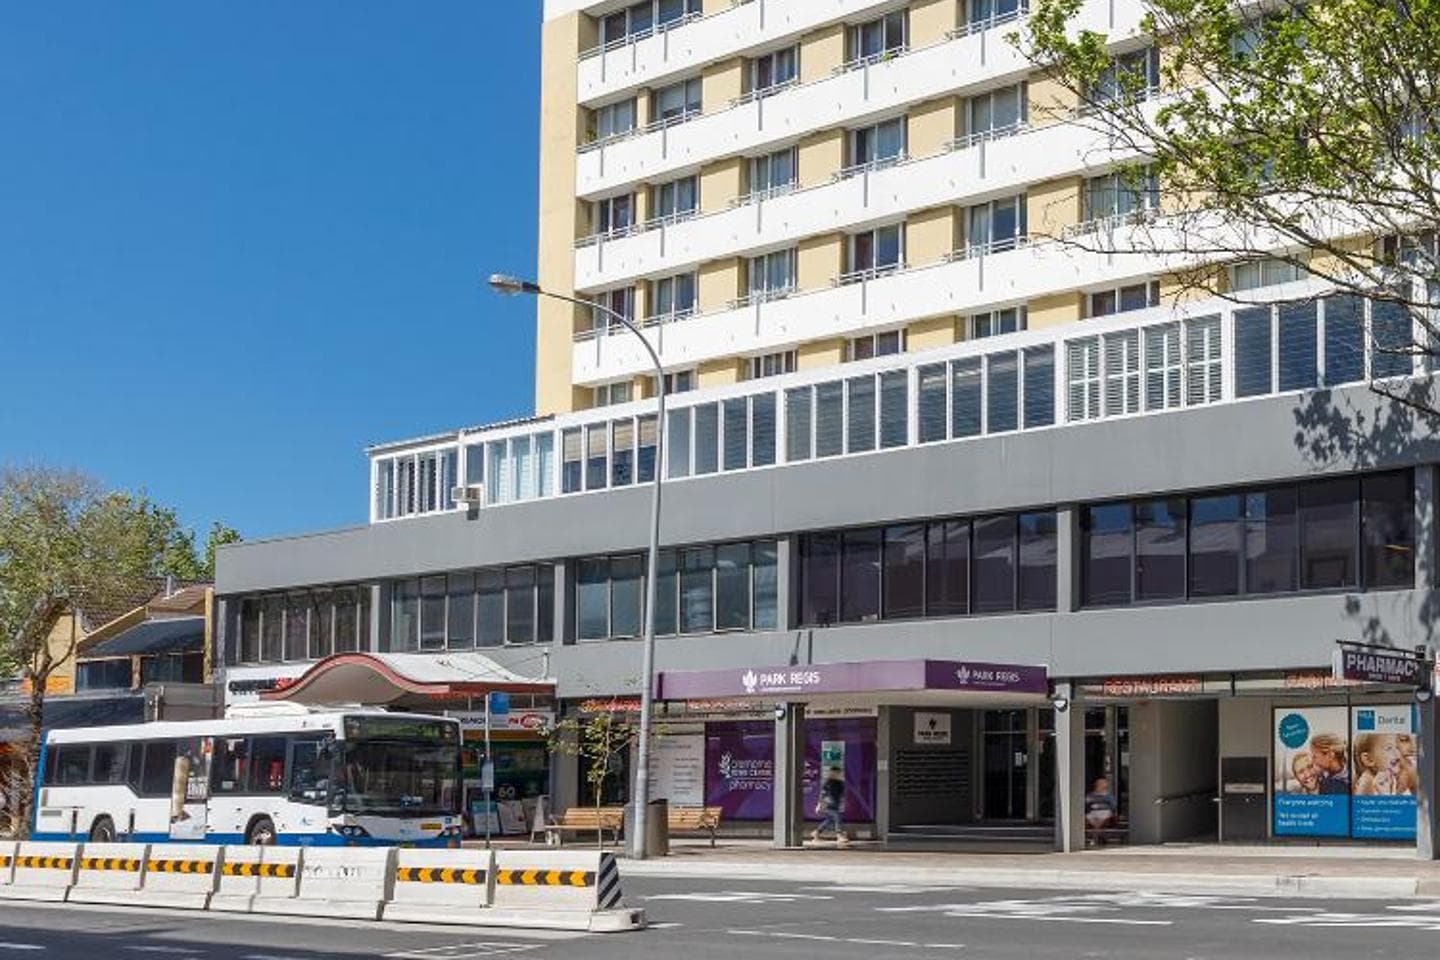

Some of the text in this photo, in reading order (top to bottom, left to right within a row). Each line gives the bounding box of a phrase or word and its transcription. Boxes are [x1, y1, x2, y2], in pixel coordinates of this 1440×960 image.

[760, 671, 821, 685] PARK REGIS
[972, 670, 1020, 683] PARK REGIS
[1103, 678, 1201, 696] RESTAURANT
